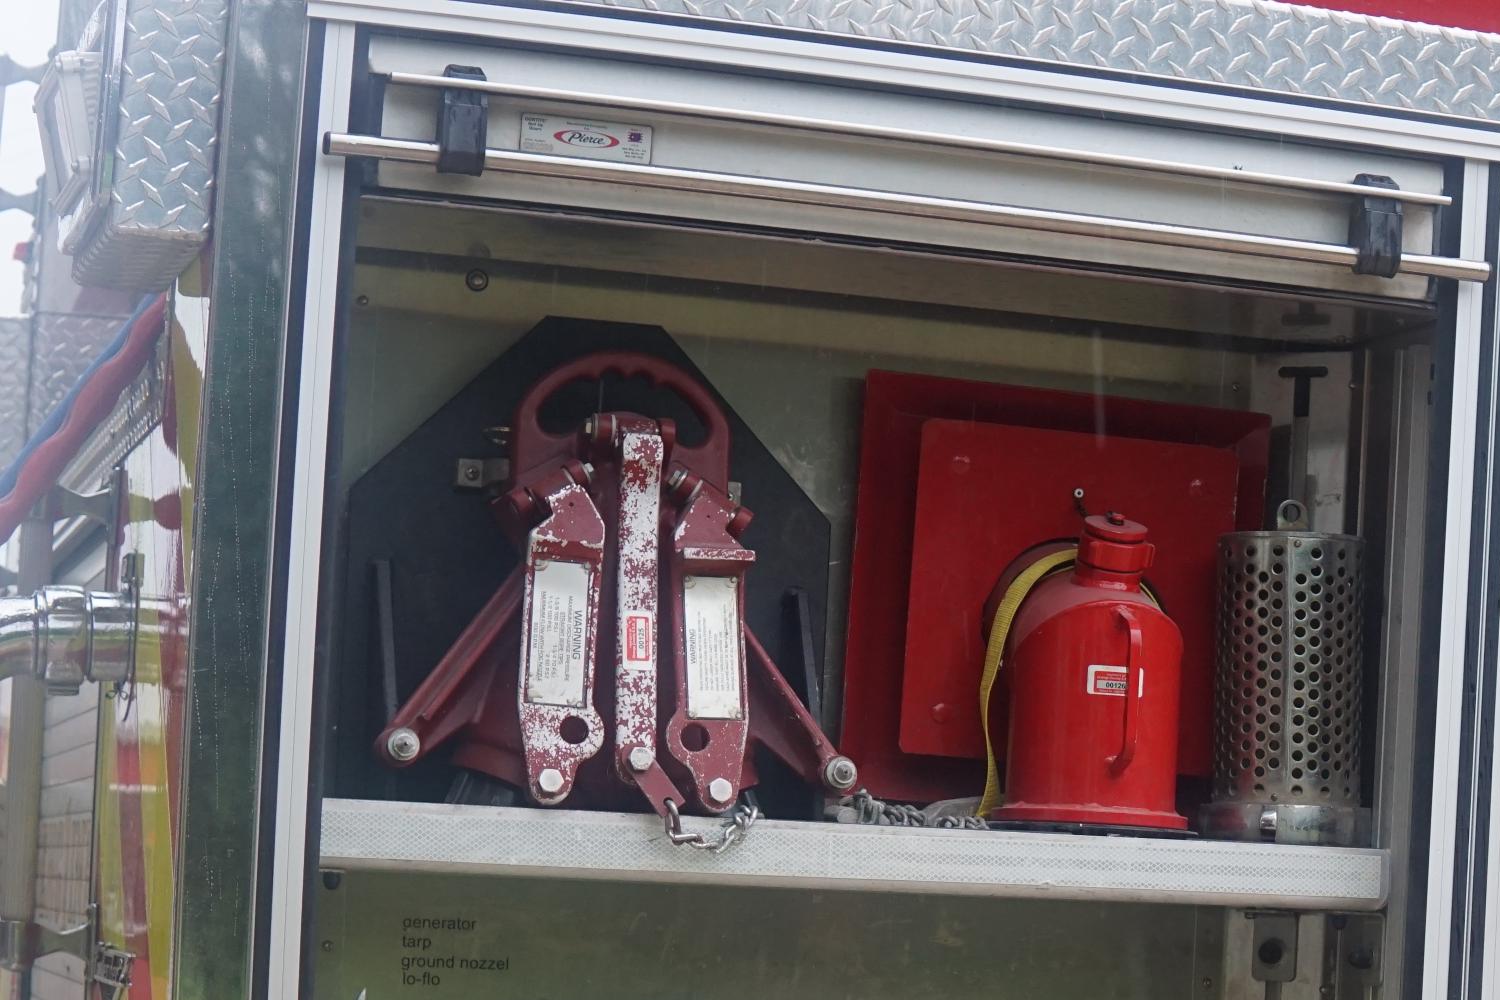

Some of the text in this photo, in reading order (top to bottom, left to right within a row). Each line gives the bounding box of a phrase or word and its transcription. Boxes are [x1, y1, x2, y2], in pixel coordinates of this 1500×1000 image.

[568, 131, 605, 145] Pierce
[572, 610, 583, 660] WARNING
[403, 917, 477, 932] generator
[402, 936, 432, 951] tarp
[401, 955, 510, 971] ground nozzel
[402, 971, 441, 986] lo-flo
